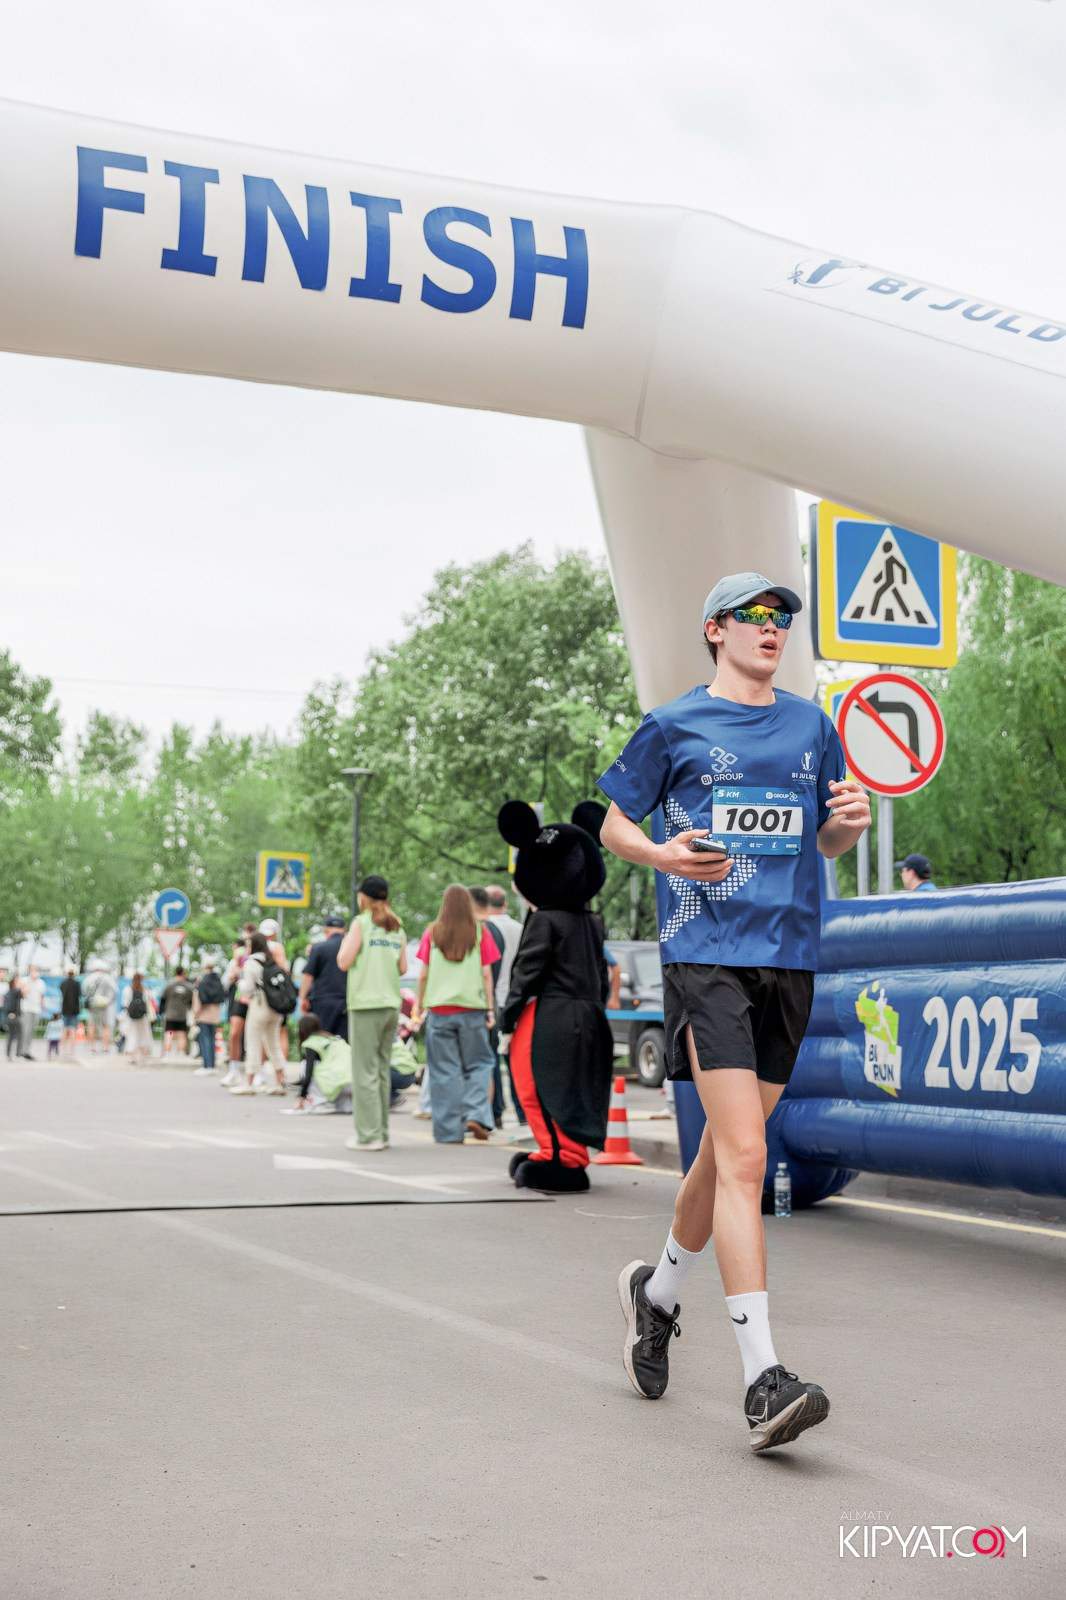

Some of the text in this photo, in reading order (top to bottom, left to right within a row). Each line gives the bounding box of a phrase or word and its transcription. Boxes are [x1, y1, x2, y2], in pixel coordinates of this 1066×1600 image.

[74, 145, 589, 329] FINISH
[866, 276, 1066, 342] BI JULD
[713, 772, 744, 782] GROUP
[717, 789, 725, 798] 5
[726, 808, 793, 833] 1001
[869, 1044, 878, 1062] BI
[922, 995, 1042, 1095] 2025
[873, 1063, 895, 1082] RUN
